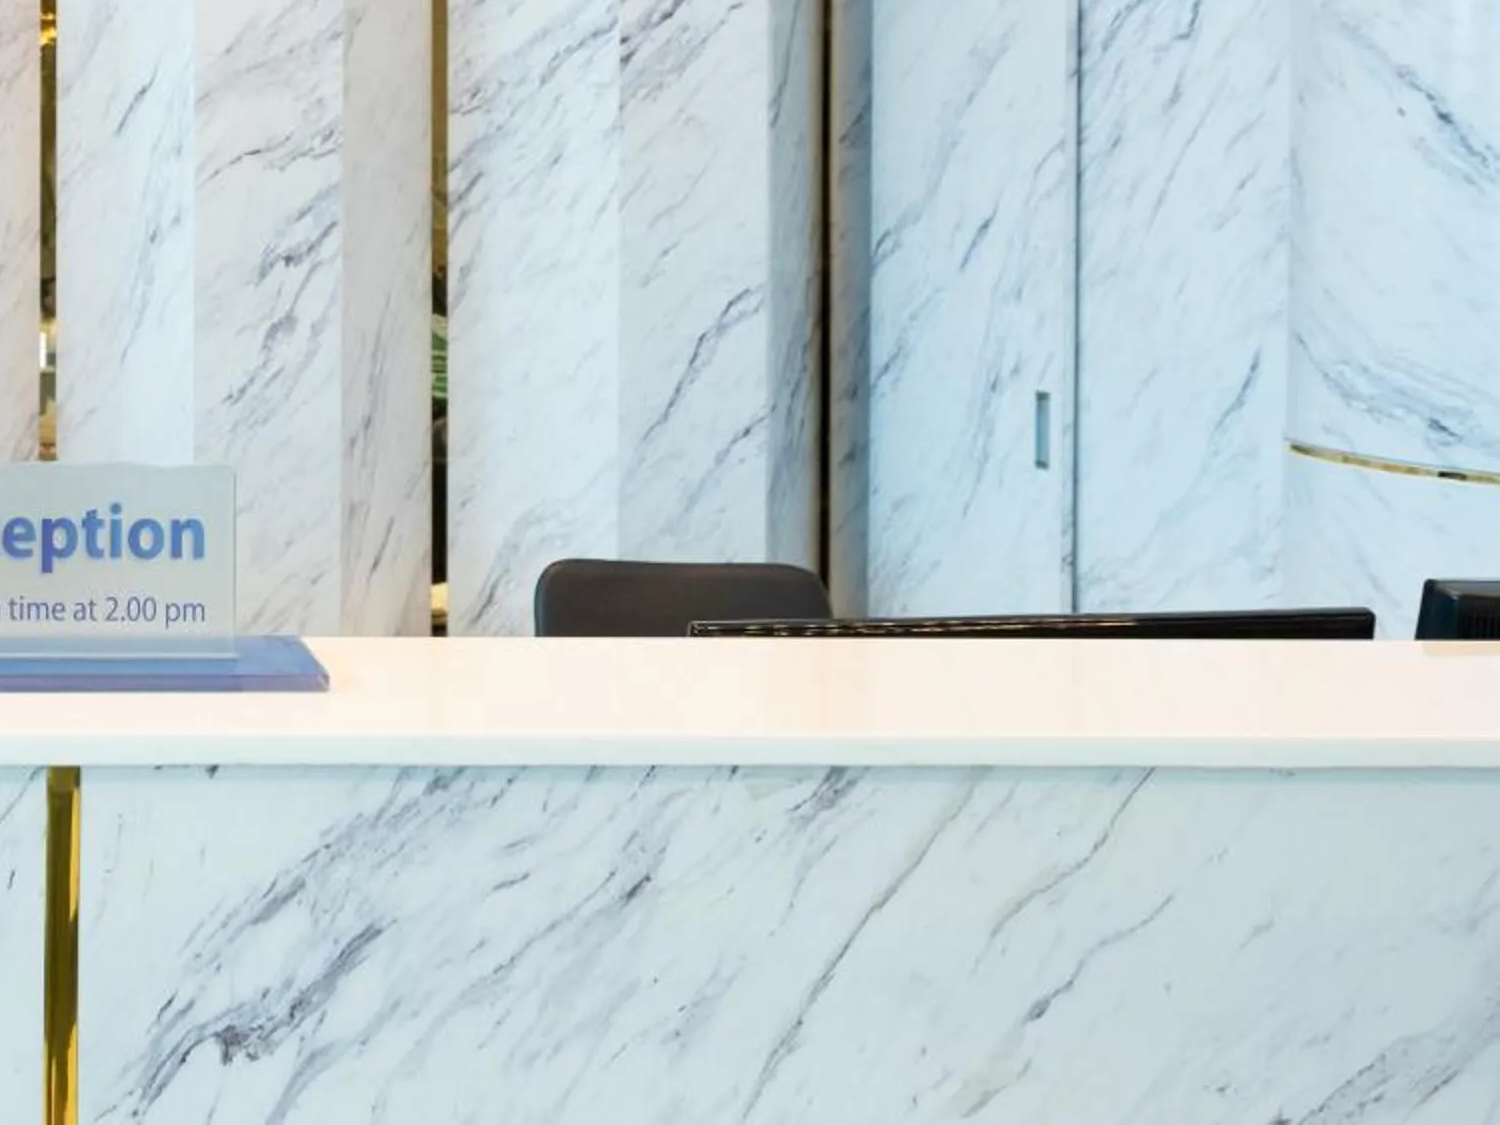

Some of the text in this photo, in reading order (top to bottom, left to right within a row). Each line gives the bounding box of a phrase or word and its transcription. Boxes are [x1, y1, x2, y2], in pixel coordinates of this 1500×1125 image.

[8, 596, 66, 621] time
[73, 600, 97, 622] at
[105, 596, 157, 622] 2.00
[165, 602, 206, 628] pm
